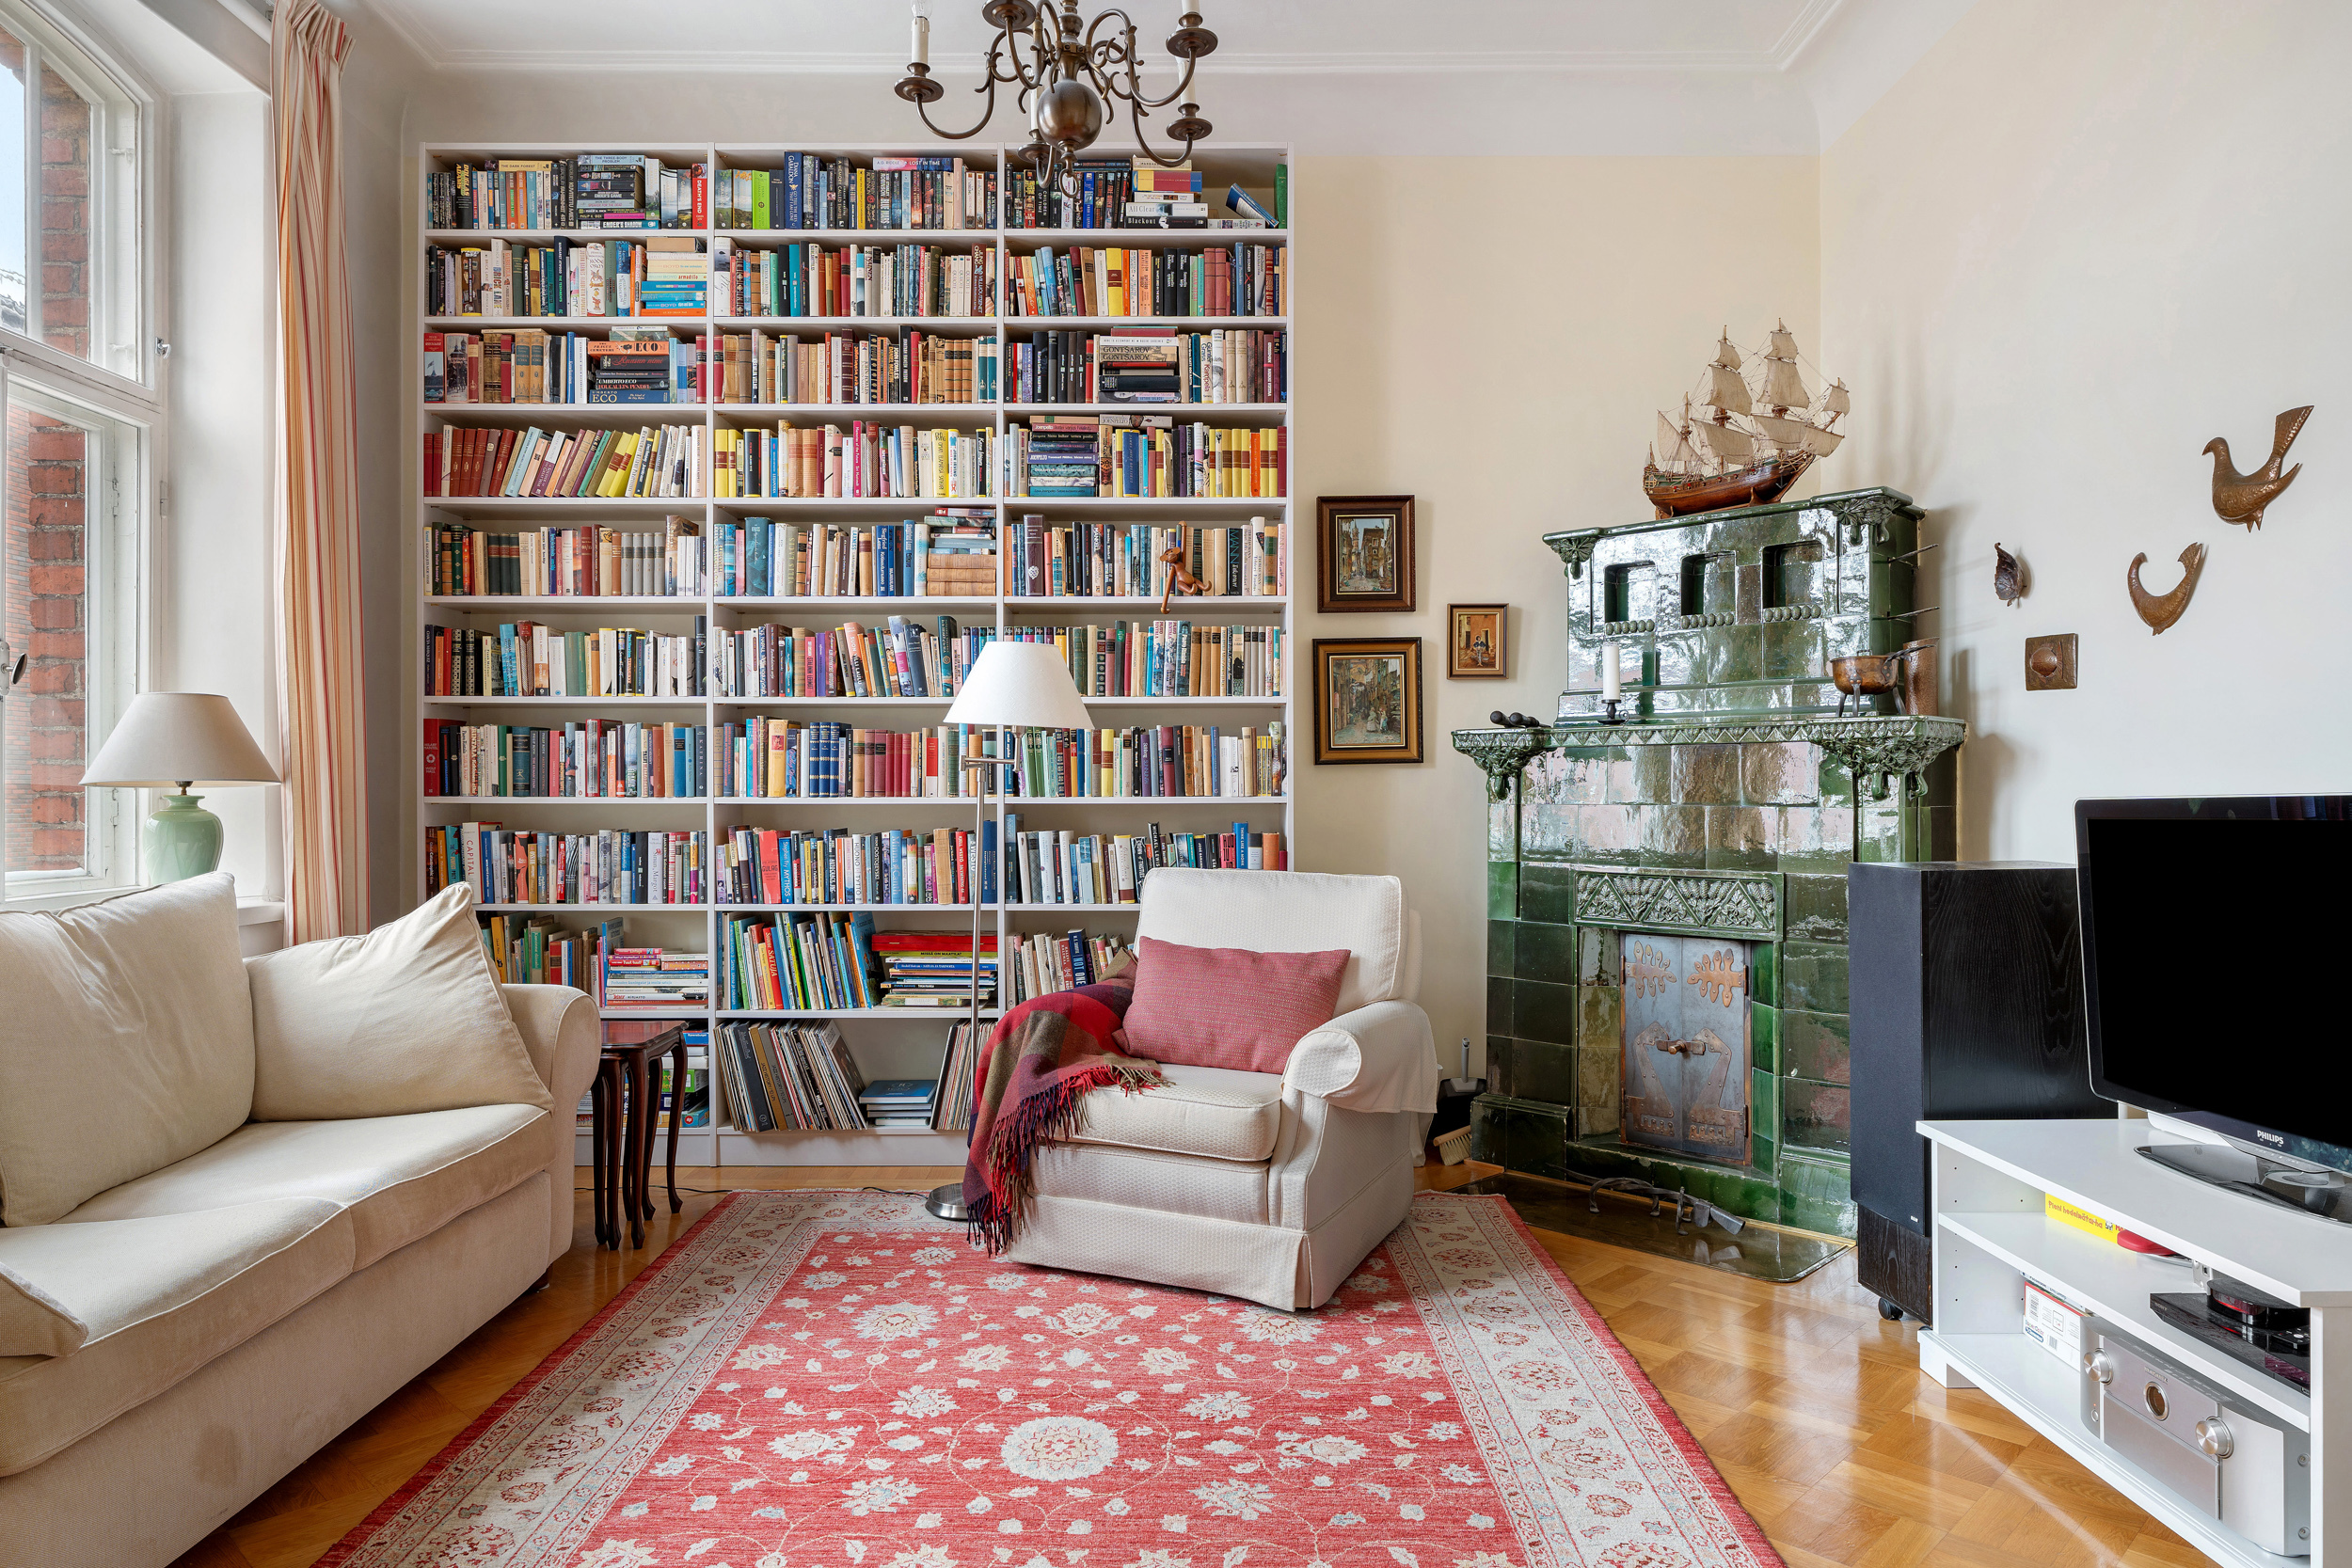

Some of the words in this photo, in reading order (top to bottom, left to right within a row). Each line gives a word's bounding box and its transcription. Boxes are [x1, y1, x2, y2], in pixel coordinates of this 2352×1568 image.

[493, 266, 502, 289] BRICK
[493, 291, 502, 309] LANE
[635, 342, 659, 352] ECO
[592, 394, 618, 403] ECO
[1230, 529, 1240, 564] MANN
[851, 653, 860, 667] VILLI
[466, 839, 474, 876] CAPITAL
[891, 835, 901, 863] Minna
[651, 870, 660, 893] Margot
[783, 869, 791, 897] MYTHOS
[891, 869, 901, 895] Canth
[769, 949, 778, 976] SATUJA
[1073, 956, 1084, 970] NOT
[1074, 972, 1085, 985] ONE
[2257, 1130, 2284, 1145] PHILIPS
